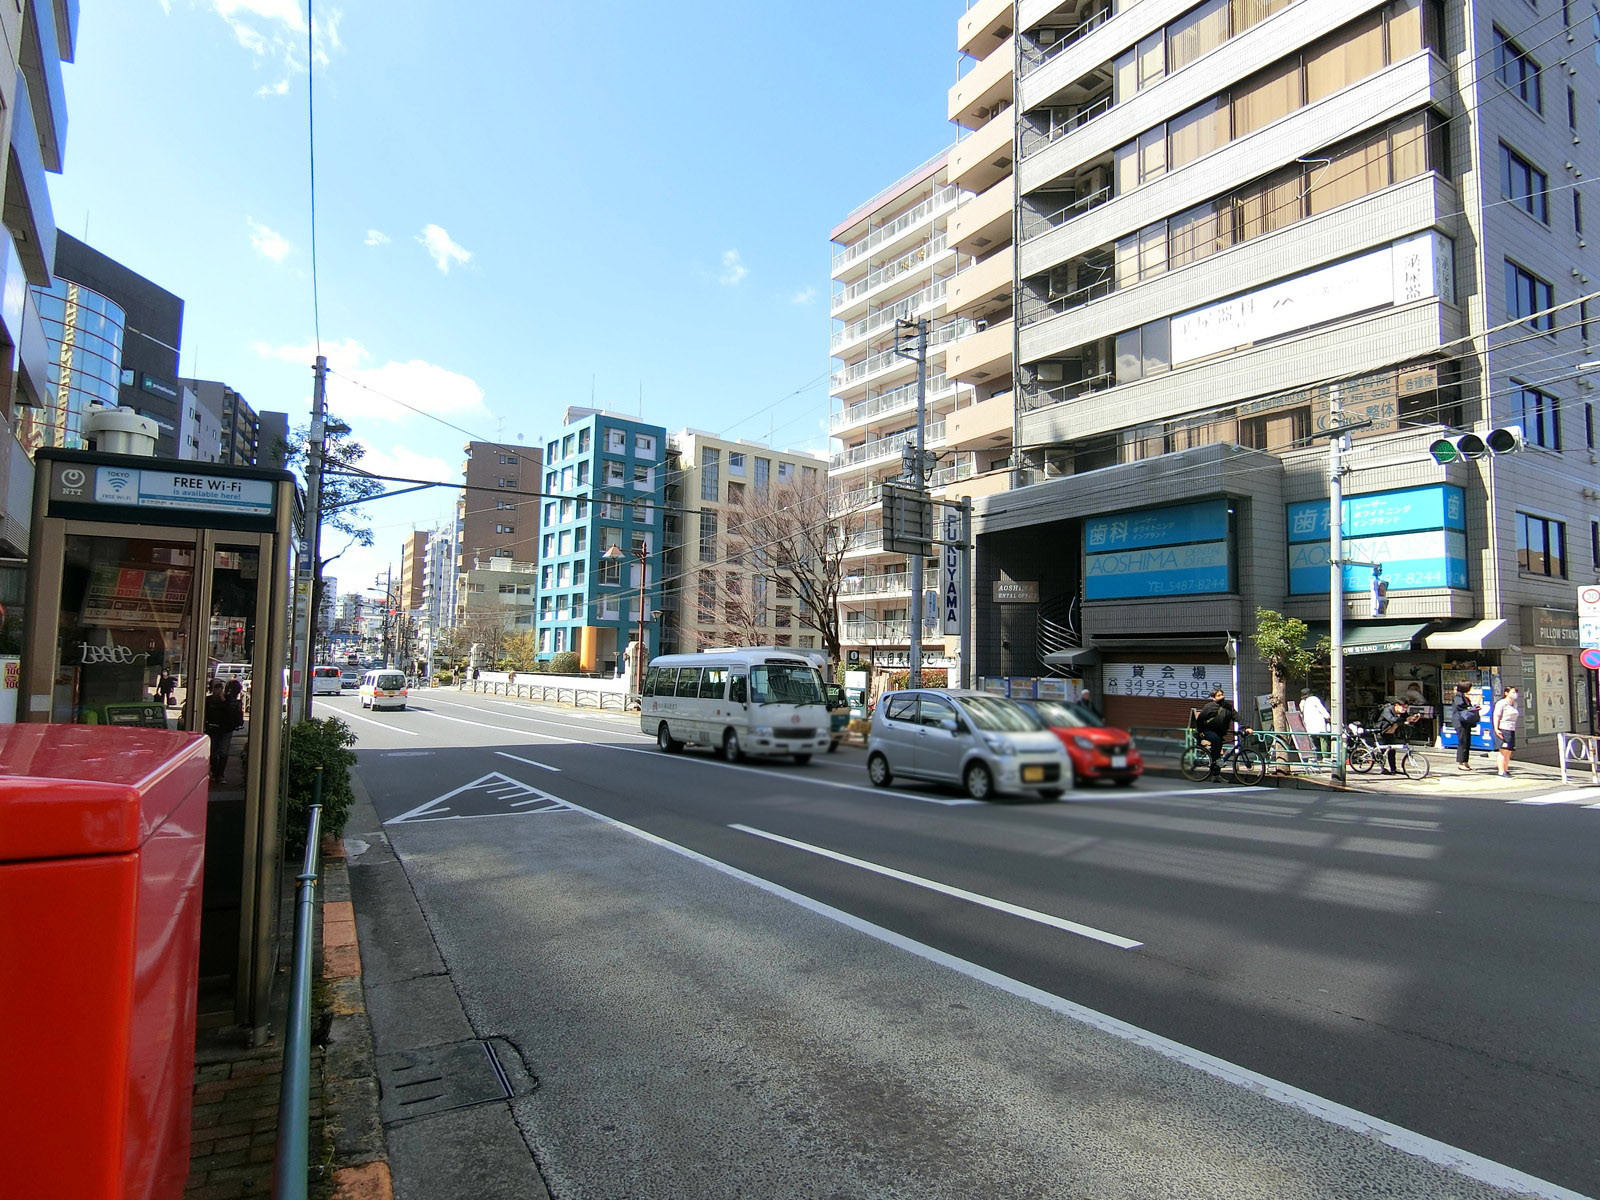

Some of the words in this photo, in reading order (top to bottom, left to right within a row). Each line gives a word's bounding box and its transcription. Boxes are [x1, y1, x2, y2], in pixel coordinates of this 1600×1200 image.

[107, 470, 130, 478] TOKYO
[173, 477, 203, 489] FREE
[208, 478, 242, 492] Wi-Fi
[62, 487, 83, 496] NTT
[173, 488, 180, 496] is
[181, 489, 219, 499] available
[219, 491, 241, 500] here!
[1355, 500, 1388, 510] レーザー
[1448, 494, 1460, 520] 歯
[1353, 505, 1412, 518] ホワイトニング
[1352, 516, 1401, 527] インプラント
[1089, 519, 1129, 545] 歯科
[1089, 550, 1178, 574] AOSHIMA
[1540, 627, 1561, 639] PILLOW
[1561, 629, 1578, 640] STAND
[1355, 645, 1378, 653] STAND
[1132, 665, 1206, 680] 貸会場
[1125, 680, 1222, 690] 3492-8019
[1125, 688, 1212, 699] 3779-045
